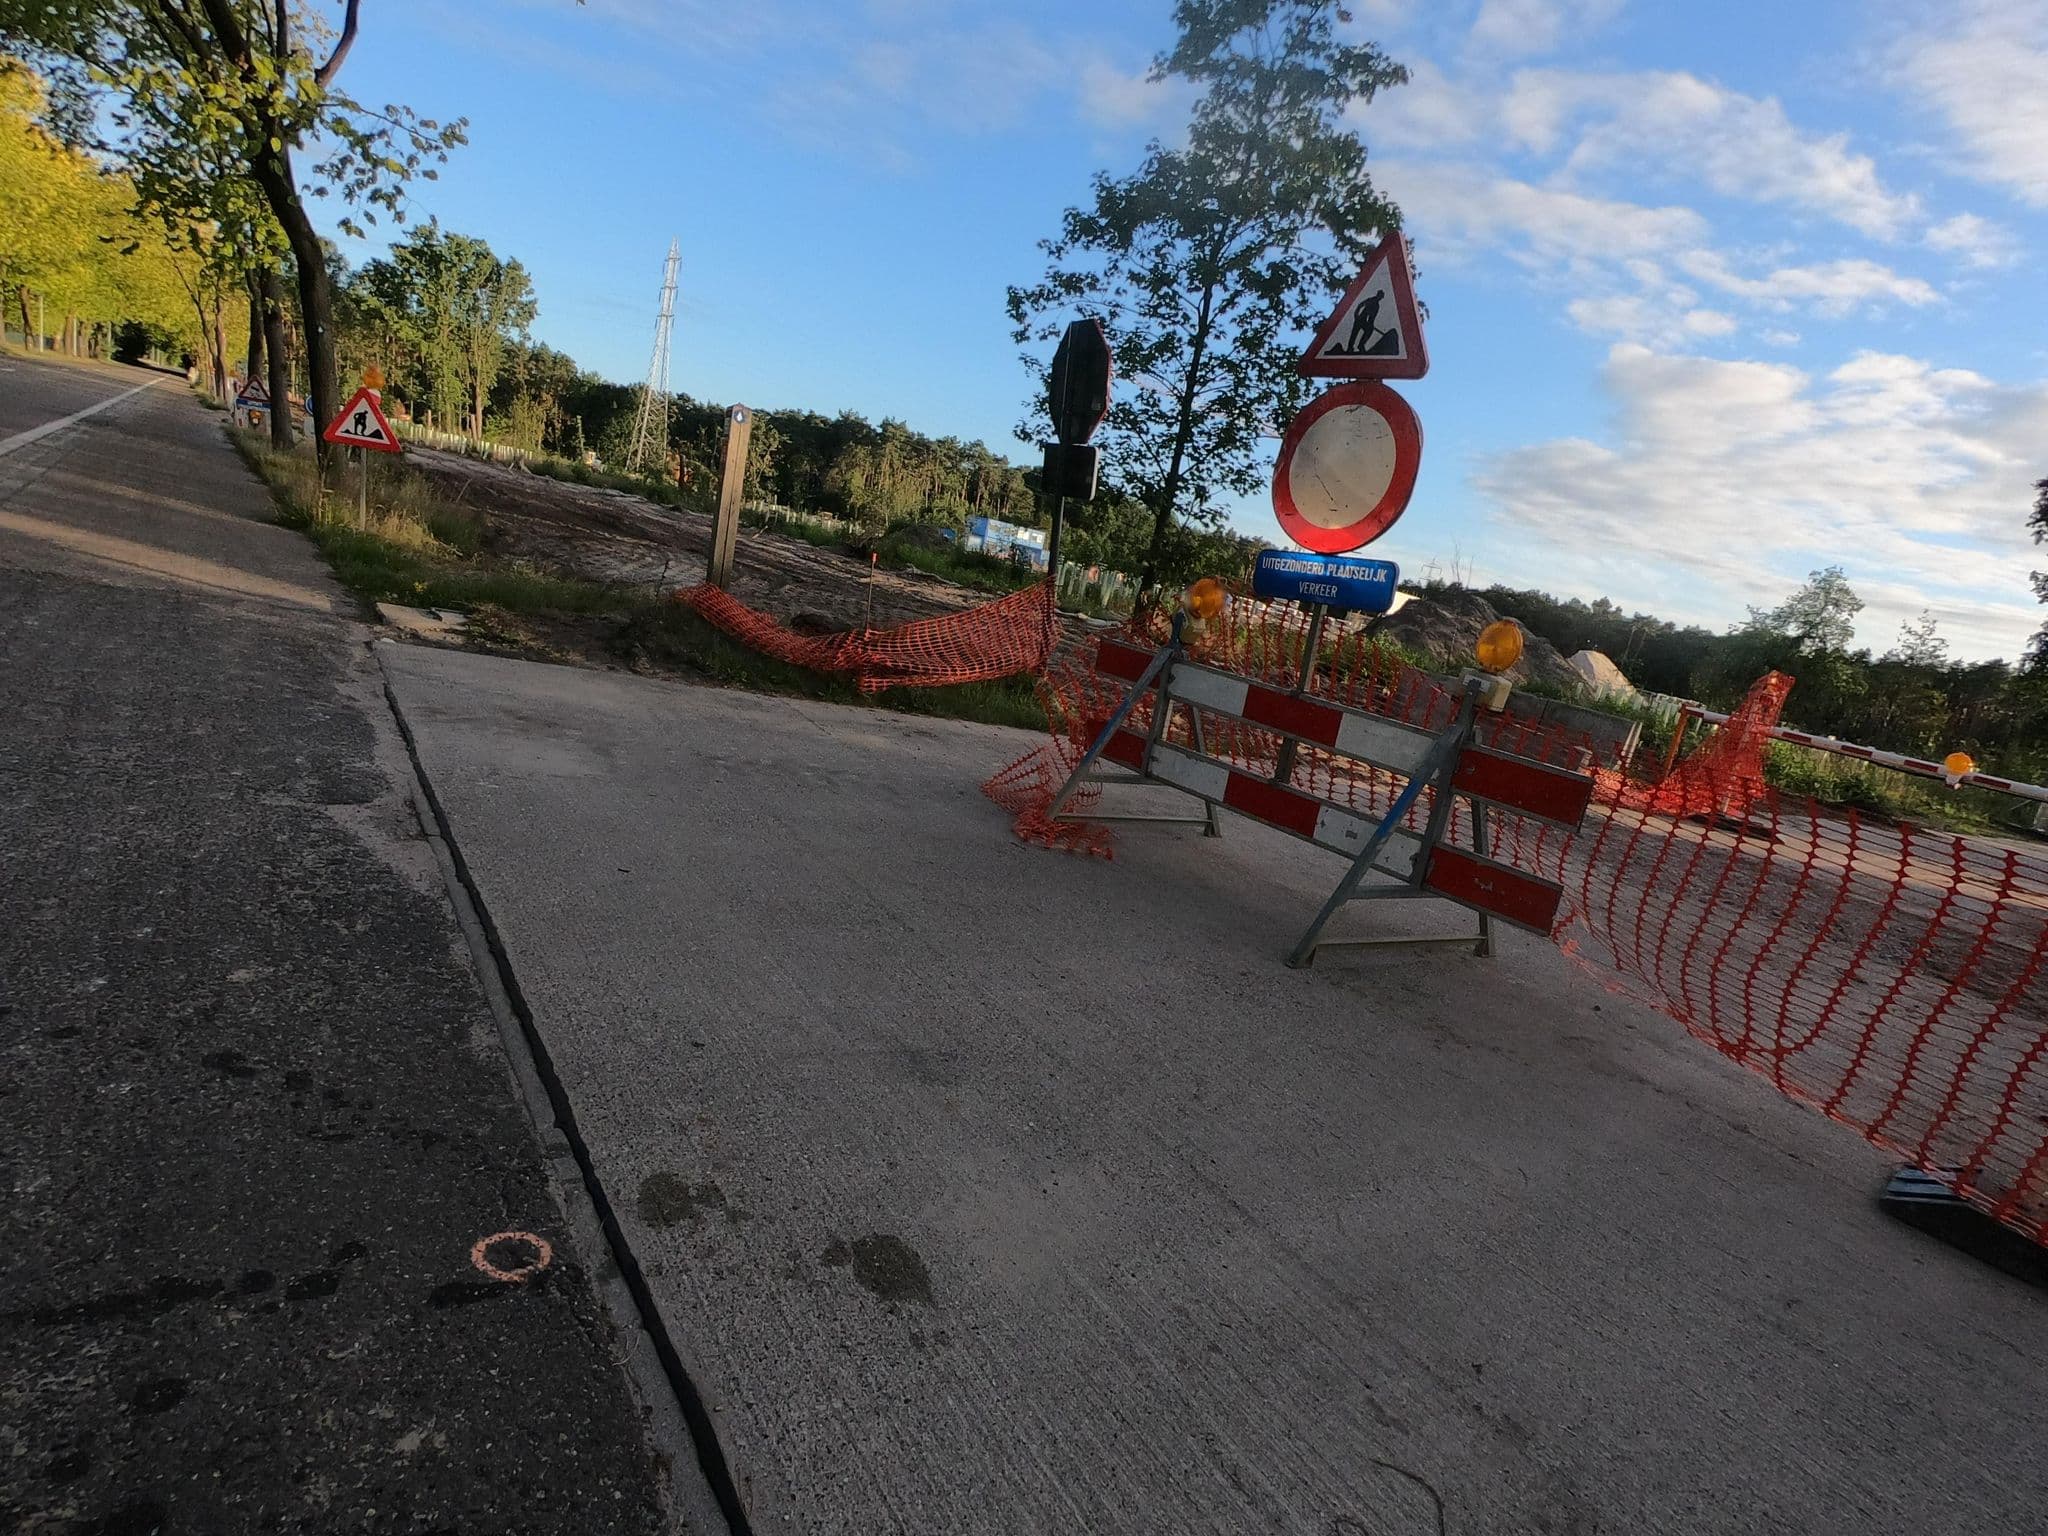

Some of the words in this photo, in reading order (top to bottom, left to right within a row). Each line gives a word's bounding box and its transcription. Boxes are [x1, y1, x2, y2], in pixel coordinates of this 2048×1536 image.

[1262, 557, 1324, 575] UITGEZONDERD
[1327, 563, 1387, 582] PLAATSELIJK
[1299, 581, 1338, 597] VERKEER
